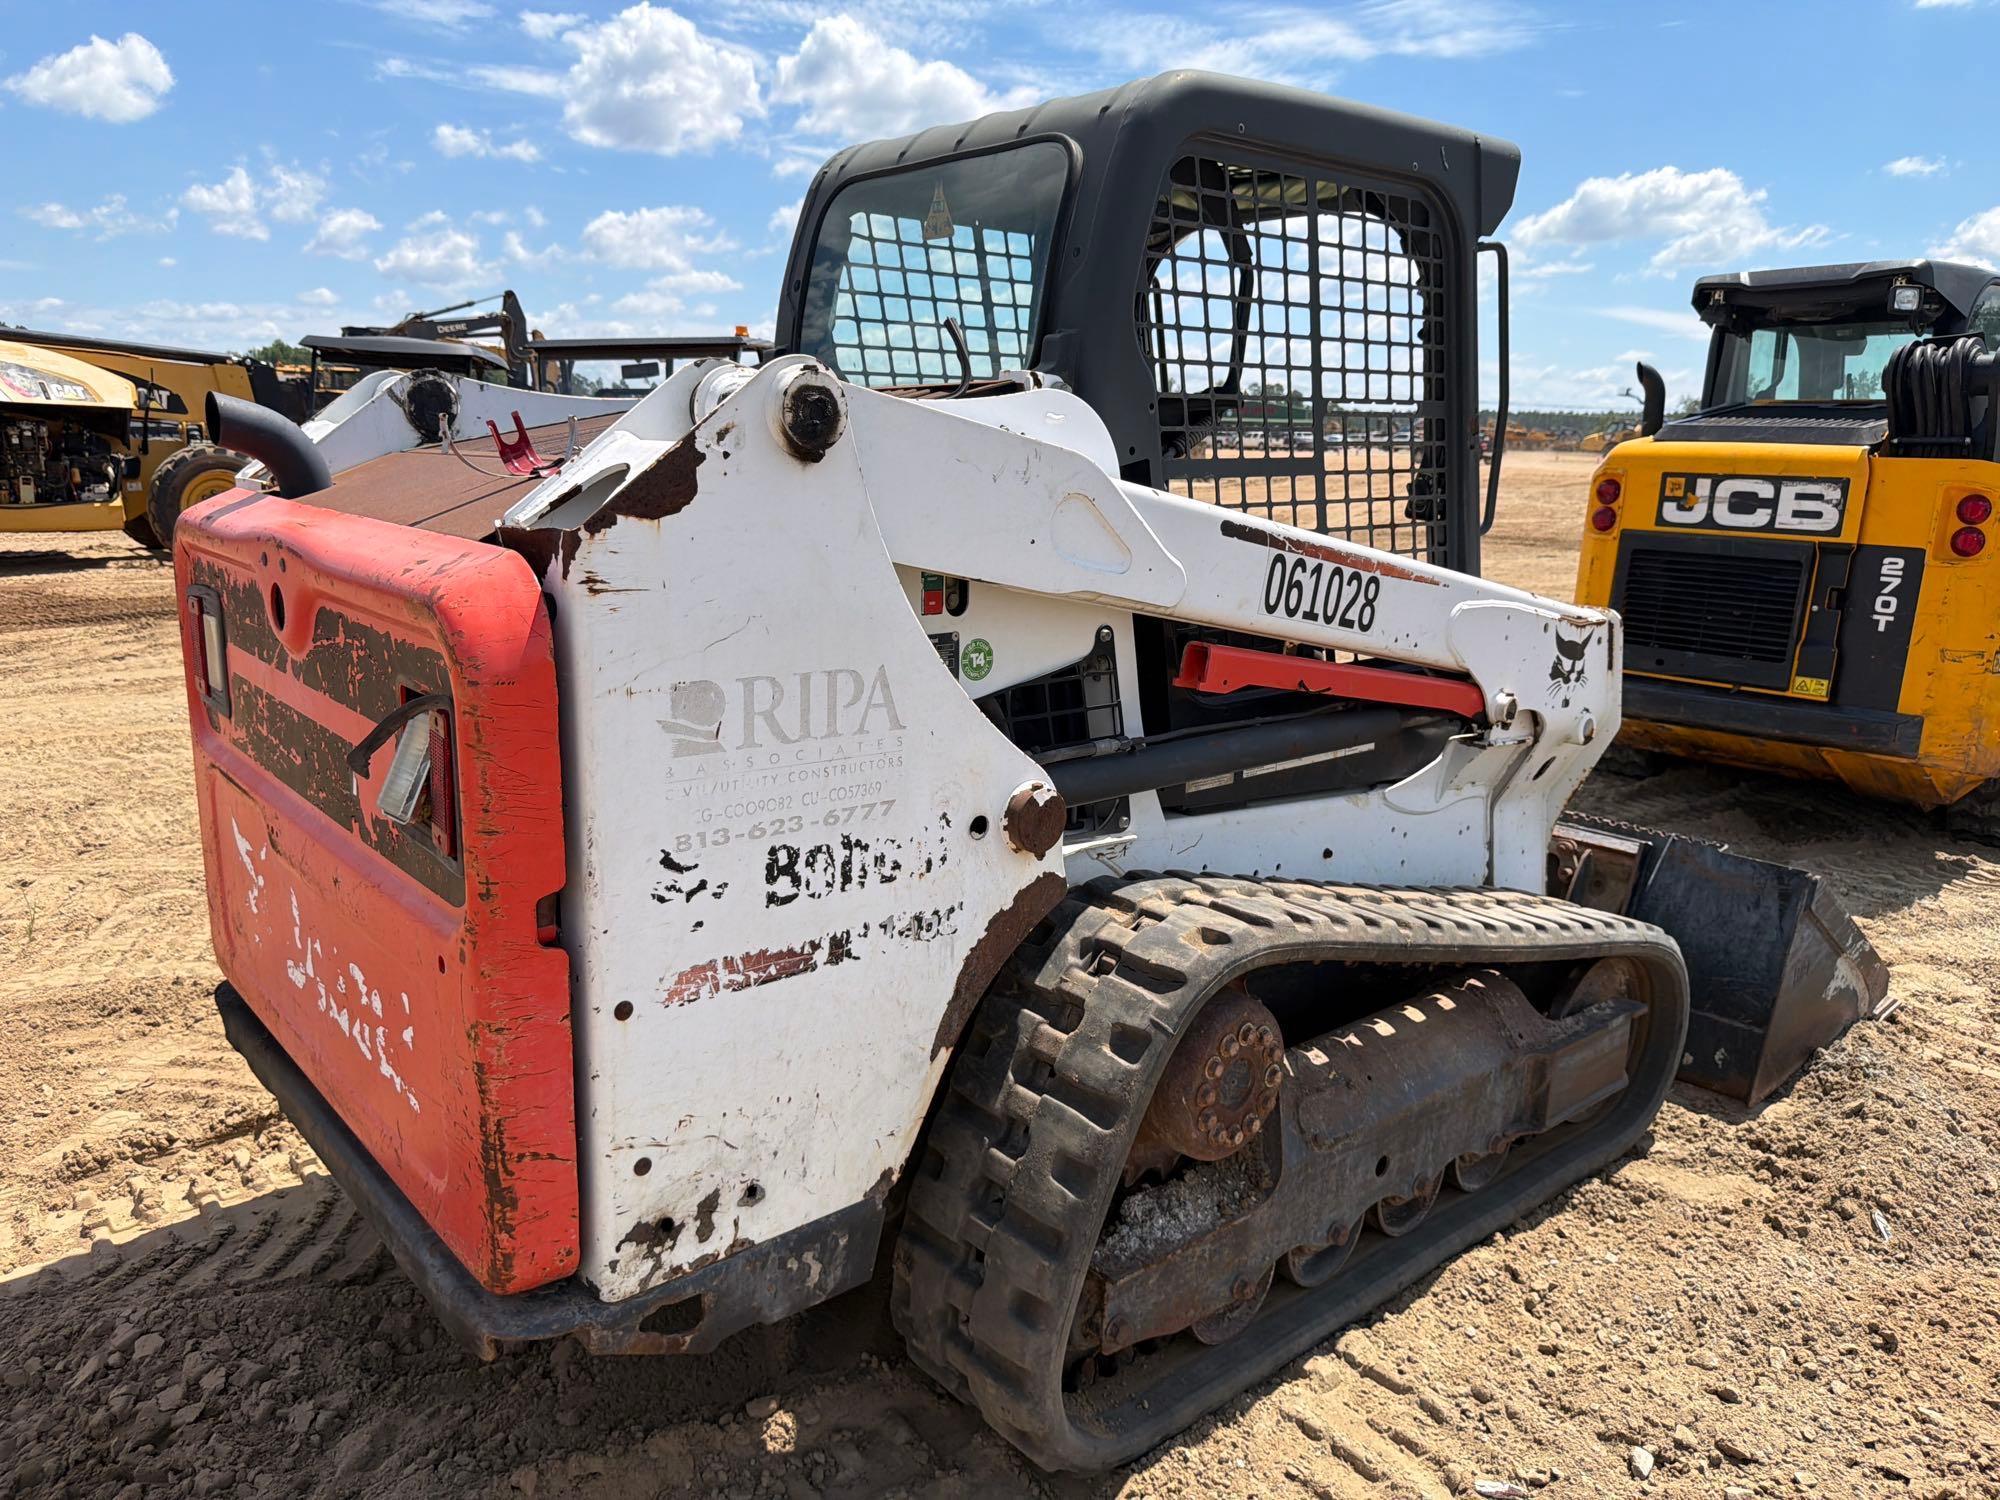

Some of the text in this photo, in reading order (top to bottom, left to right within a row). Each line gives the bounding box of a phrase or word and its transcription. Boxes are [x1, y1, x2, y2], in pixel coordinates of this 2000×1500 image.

[437, 323, 468, 334] DEERE
[51, 384, 87, 401] CAT
[1662, 478, 1842, 532] JCB
[1264, 553, 1380, 633] 061028
[1872, 557, 1905, 632] 270T
[970, 652, 985, 668] T4
[736, 664, 907, 750] RIPA
[788, 756, 903, 783] CONSTRUCTORS
[675, 799, 897, 854] 813-623-6777
